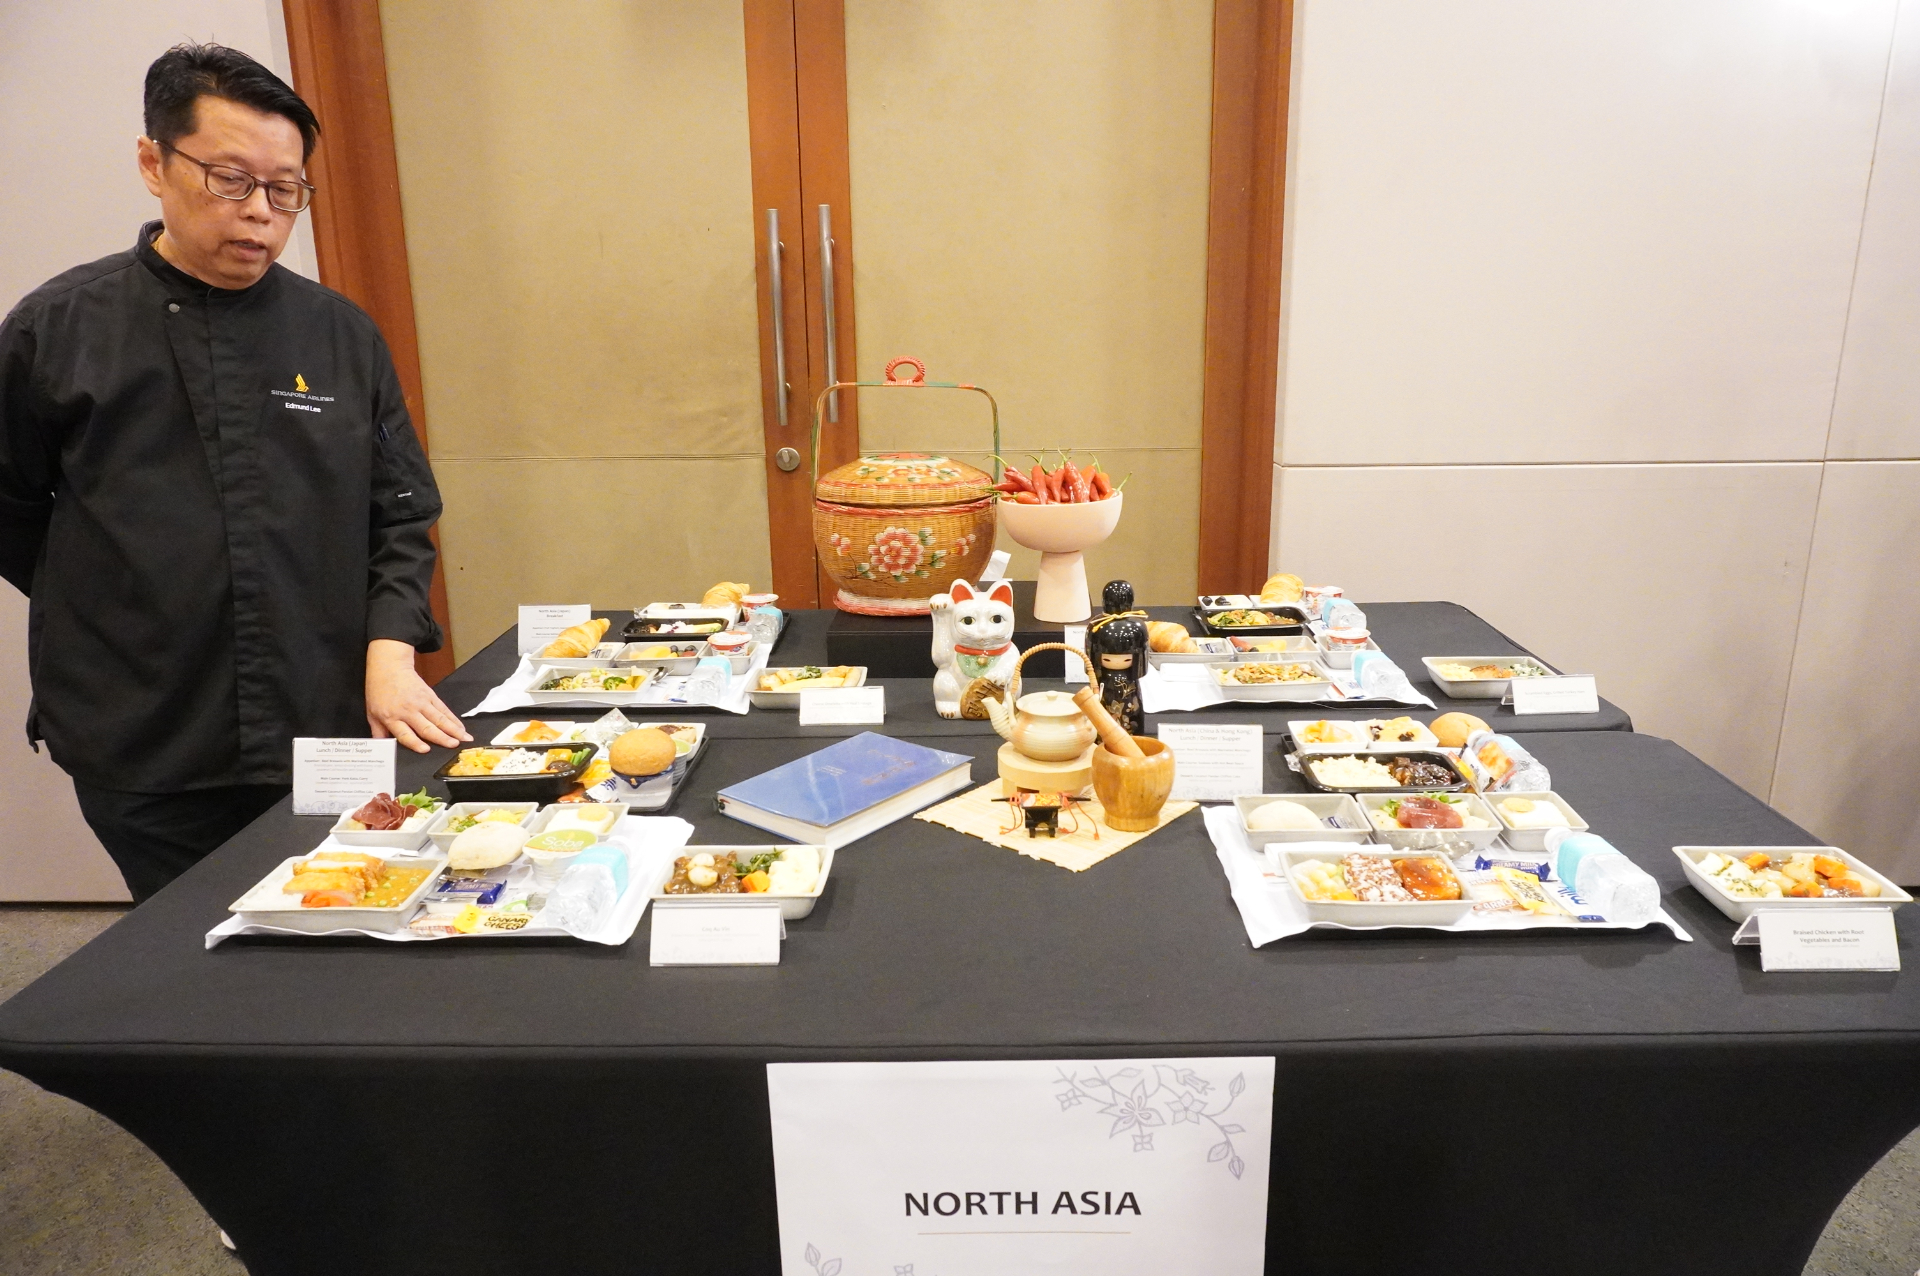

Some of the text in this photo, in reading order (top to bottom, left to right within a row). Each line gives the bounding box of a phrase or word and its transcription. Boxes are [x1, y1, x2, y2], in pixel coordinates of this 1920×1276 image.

[271, 390, 306, 399] SINGAPORE
[285, 402, 322, 413] Edmund Lee
[542, 836, 584, 846] Soba
[905, 1191, 1142, 1216] NORTH ASIA
